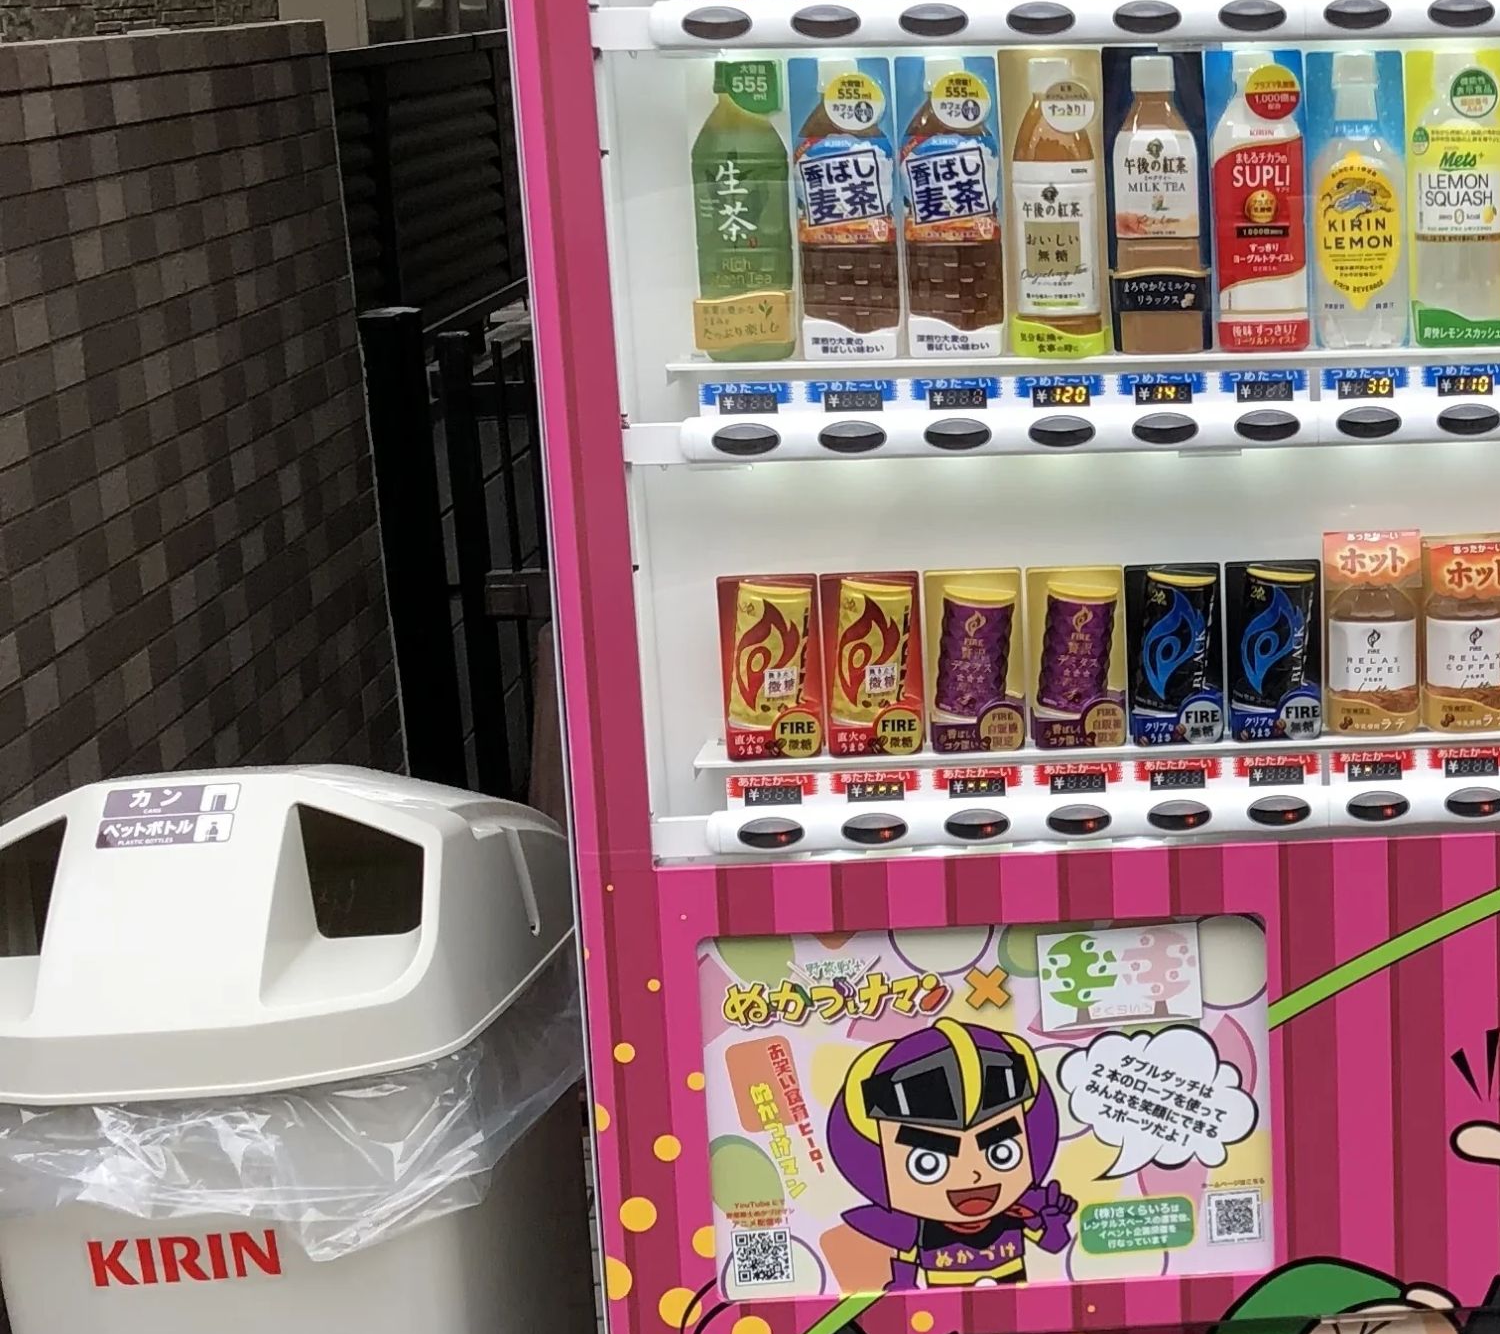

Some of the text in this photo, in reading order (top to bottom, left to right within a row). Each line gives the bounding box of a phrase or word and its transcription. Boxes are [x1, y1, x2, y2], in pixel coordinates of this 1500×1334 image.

[732, 76, 768, 101] 555 ml
[837, 88, 861, 100] 555
[945, 86, 968, 98] 555
[1048, 104, 1086, 117] すっきり!
[1235, 152, 1288, 164] まもるチカラの
[910, 156, 981, 188] 香ばし
[1123, 156, 1187, 175] 午後の紅茶
[804, 158, 874, 188] 香ばし
[1232, 165, 1290, 188] SUPLI
[1128, 181, 1186, 193] MILK TEA
[1428, 174, 1489, 189] LEMON
[714, 160, 758, 243] 生茶
[809, 180, 879, 223] 麦茶
[914, 178, 987, 222] 麦茶
[1425, 191, 1493, 206] SQUASH
[1023, 201, 1083, 218] 午後の紅茶
[1328, 219, 1387, 233] KIRIN
[1026, 233, 1079, 247] おいしい
[1323, 236, 1393, 249] LEMON
[1249, 243, 1279, 253] すっきり
[1037, 250, 1069, 262] 無糖
[1233, 253, 1295, 263] ヨーグルトテイスト
[1137, 294, 1180, 306] リラックス
[811, 336, 863, 346] 深煎り大麦の
[917, 335, 969, 344] 深煎り大麦の
[821, 344, 884, 354] 香ばしい味わい
[926, 342, 990, 352] 香ばしい味わい
[1339, 547, 1406, 575] ホット
[1192, 629, 1206, 689] BLACK
[1291, 625, 1305, 683] BLACK
[1184, 710, 1220, 724] FIRE
[1285, 704, 1320, 719] FIRE
[779, 720, 816, 735] FIRE
[881, 718, 917, 733] FIRE
[1144, 722, 1175, 732] クリアな
[1245, 718, 1274, 728] クリアな
[1290, 721, 1314, 733] 無糖
[837, 732, 867, 743] 直火の
[1190, 726, 1214, 738] 無糖
[734, 735, 764, 746] 直火の
[788, 738, 813, 751] 微糖
[889, 735, 913, 749] 微糖
[128, 788, 184, 810] カン
[143, 807, 162, 815] CANS
[102, 819, 194, 839] ペットボトル
[146, 837, 174, 845] BOTTLES
[1120, 1054, 1214, 1098] ダブルダッチは
[1092, 1064, 1227, 1123] ２本のロープを使って
[1085, 1079, 1219, 1138] みんなを笑顔にできる
[1099, 1103, 1190, 1147] スポーツだよ！
[734, 1200, 770, 1209] YouTube
[1094, 1202, 1180, 1218] (株)さくらいろは
[1108, 1235, 1168, 1249] 行なっています
[86, 1229, 283, 1288] KIRIN
[936, 1241, 1016, 1267] ぬかづけ
